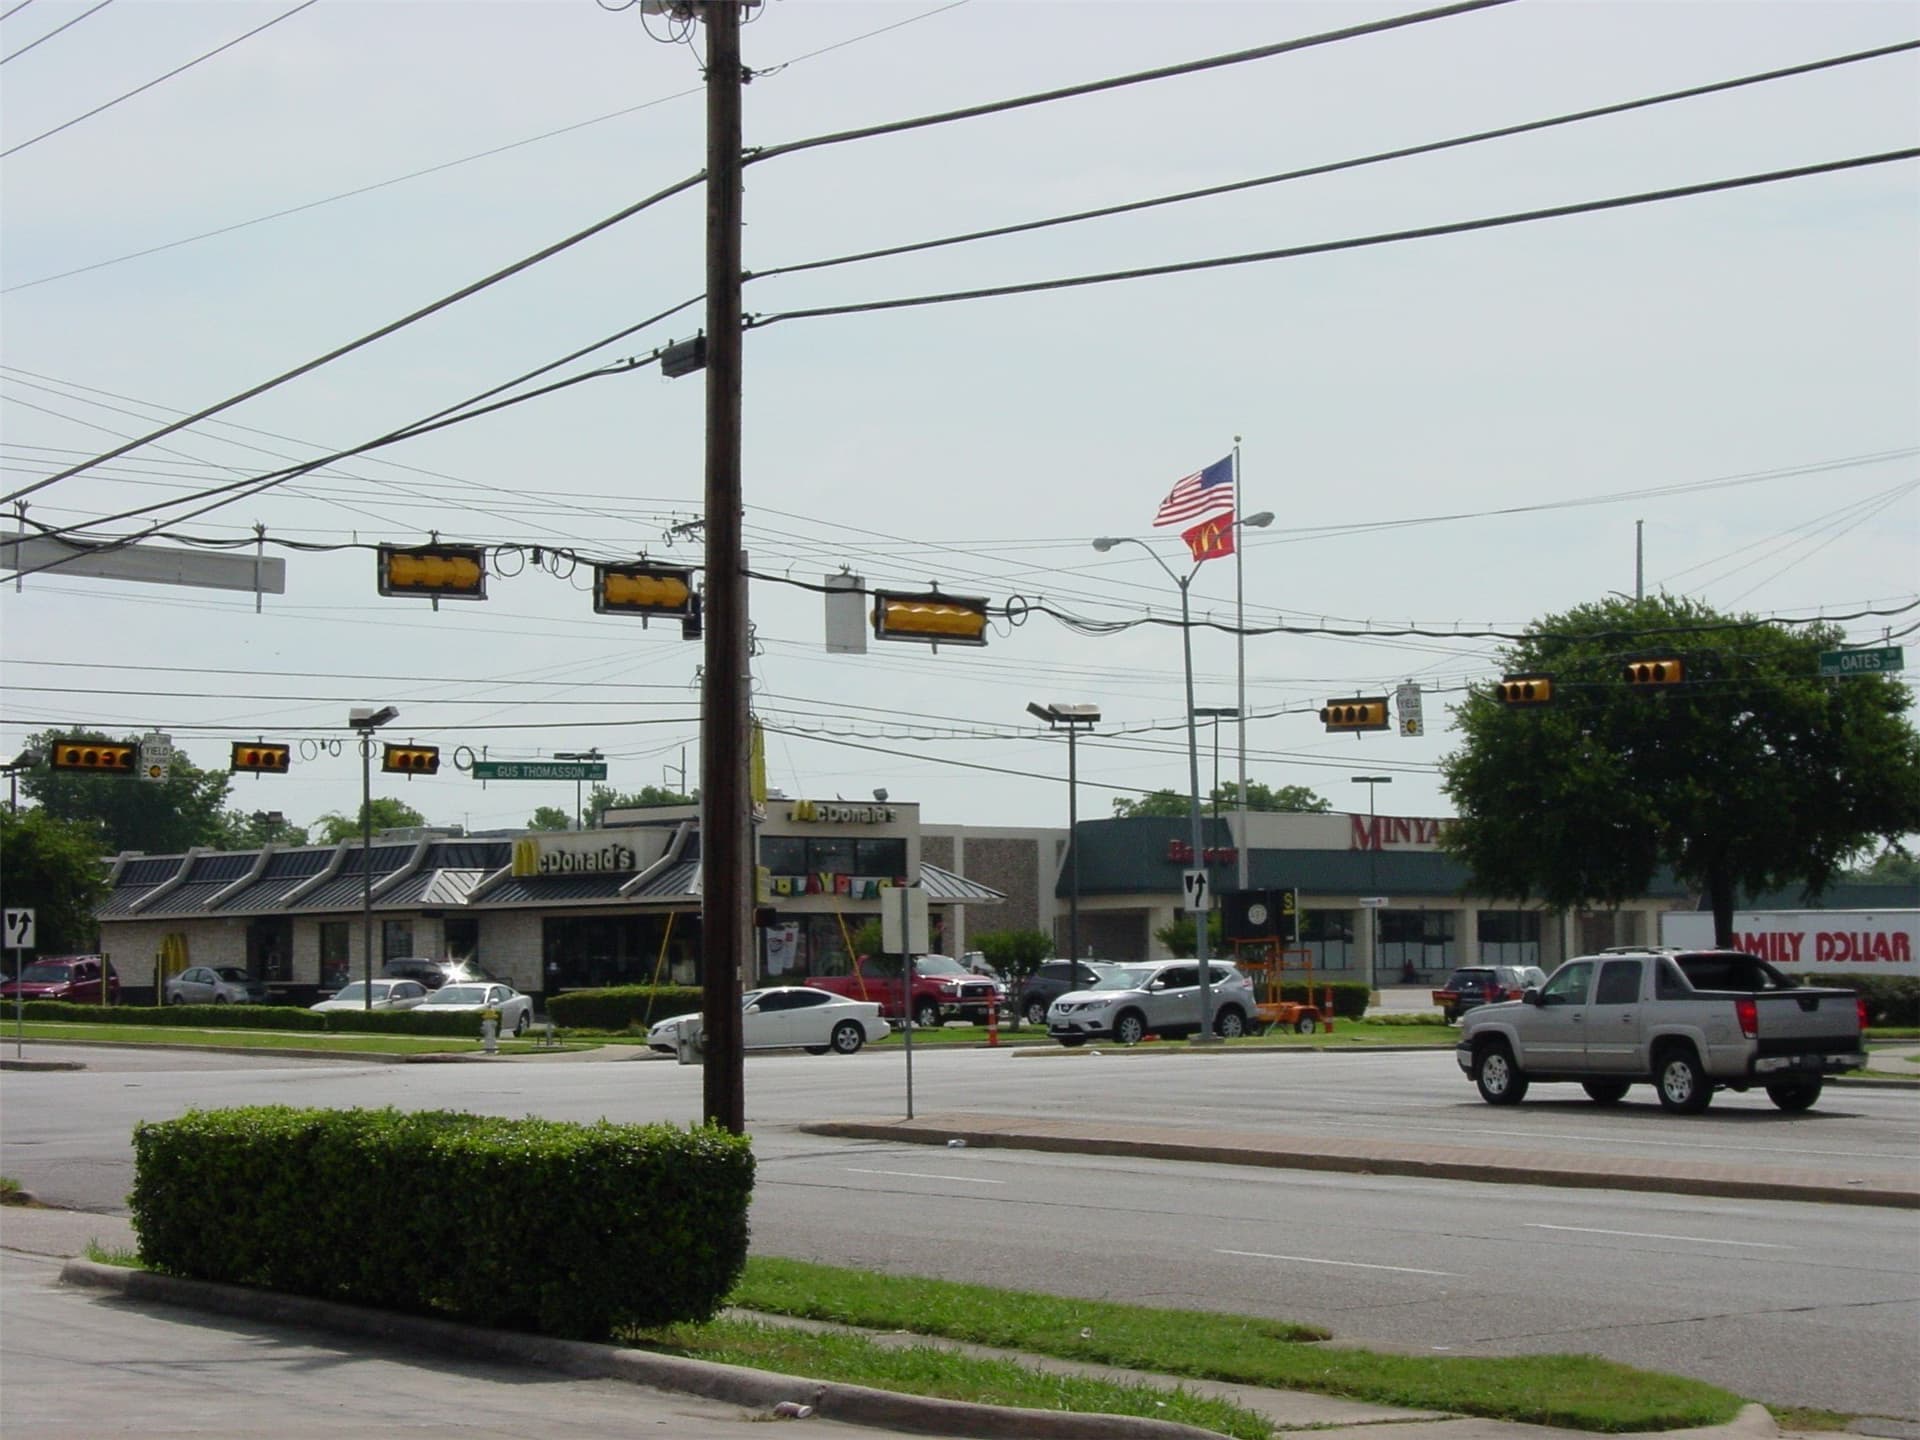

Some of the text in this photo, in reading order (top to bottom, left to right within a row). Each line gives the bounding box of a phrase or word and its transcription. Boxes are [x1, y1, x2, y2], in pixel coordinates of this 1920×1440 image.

[1841, 653, 1881, 670] OATES
[144, 746, 169, 756] YIELD
[496, 765, 519, 777] GUS
[523, 765, 585, 778] THOMASSON
[514, 839, 636, 875] McDonald's
[1730, 931, 1911, 962] AMILY DOLLAR
